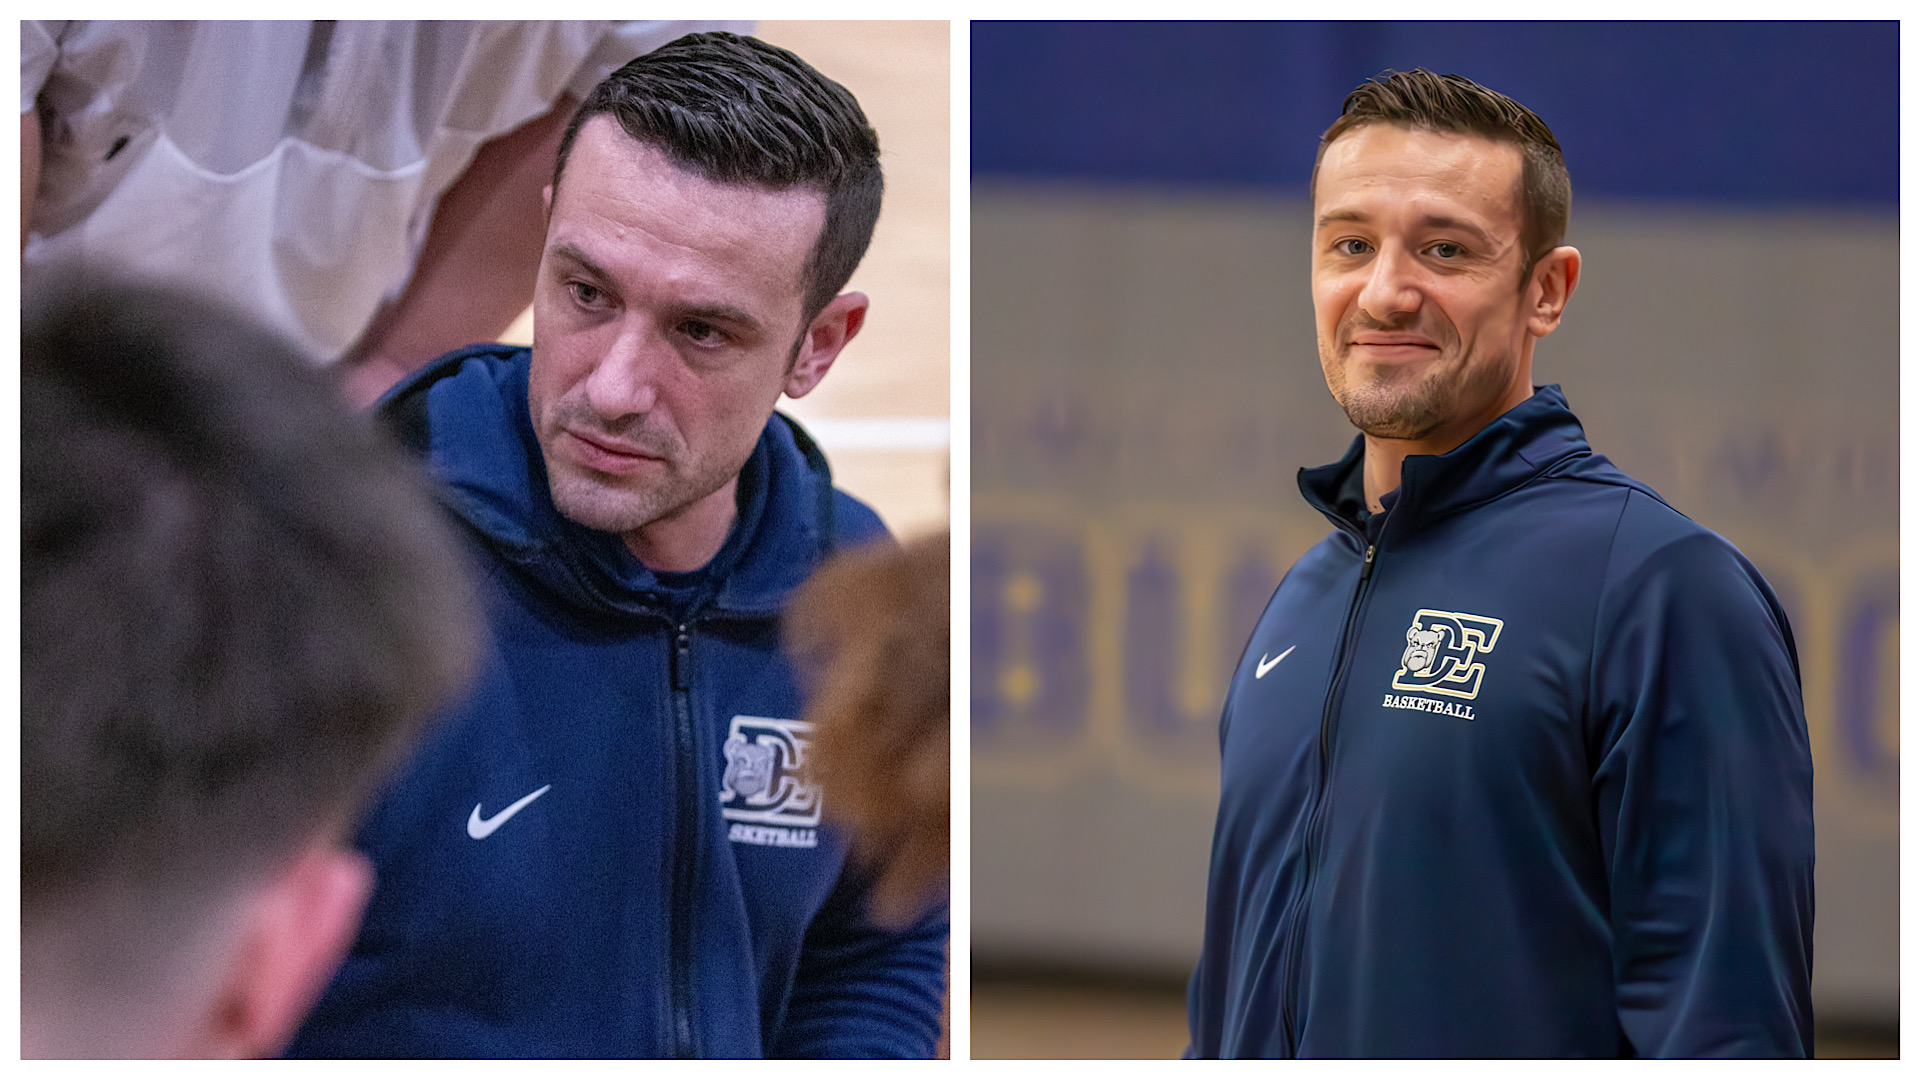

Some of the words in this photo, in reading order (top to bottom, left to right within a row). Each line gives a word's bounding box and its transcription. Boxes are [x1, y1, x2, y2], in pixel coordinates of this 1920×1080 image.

[1392, 609, 1504, 700] DE
[1382, 694, 1475, 720] BASKETBALL
[728, 823, 818, 848] SKETBALL
